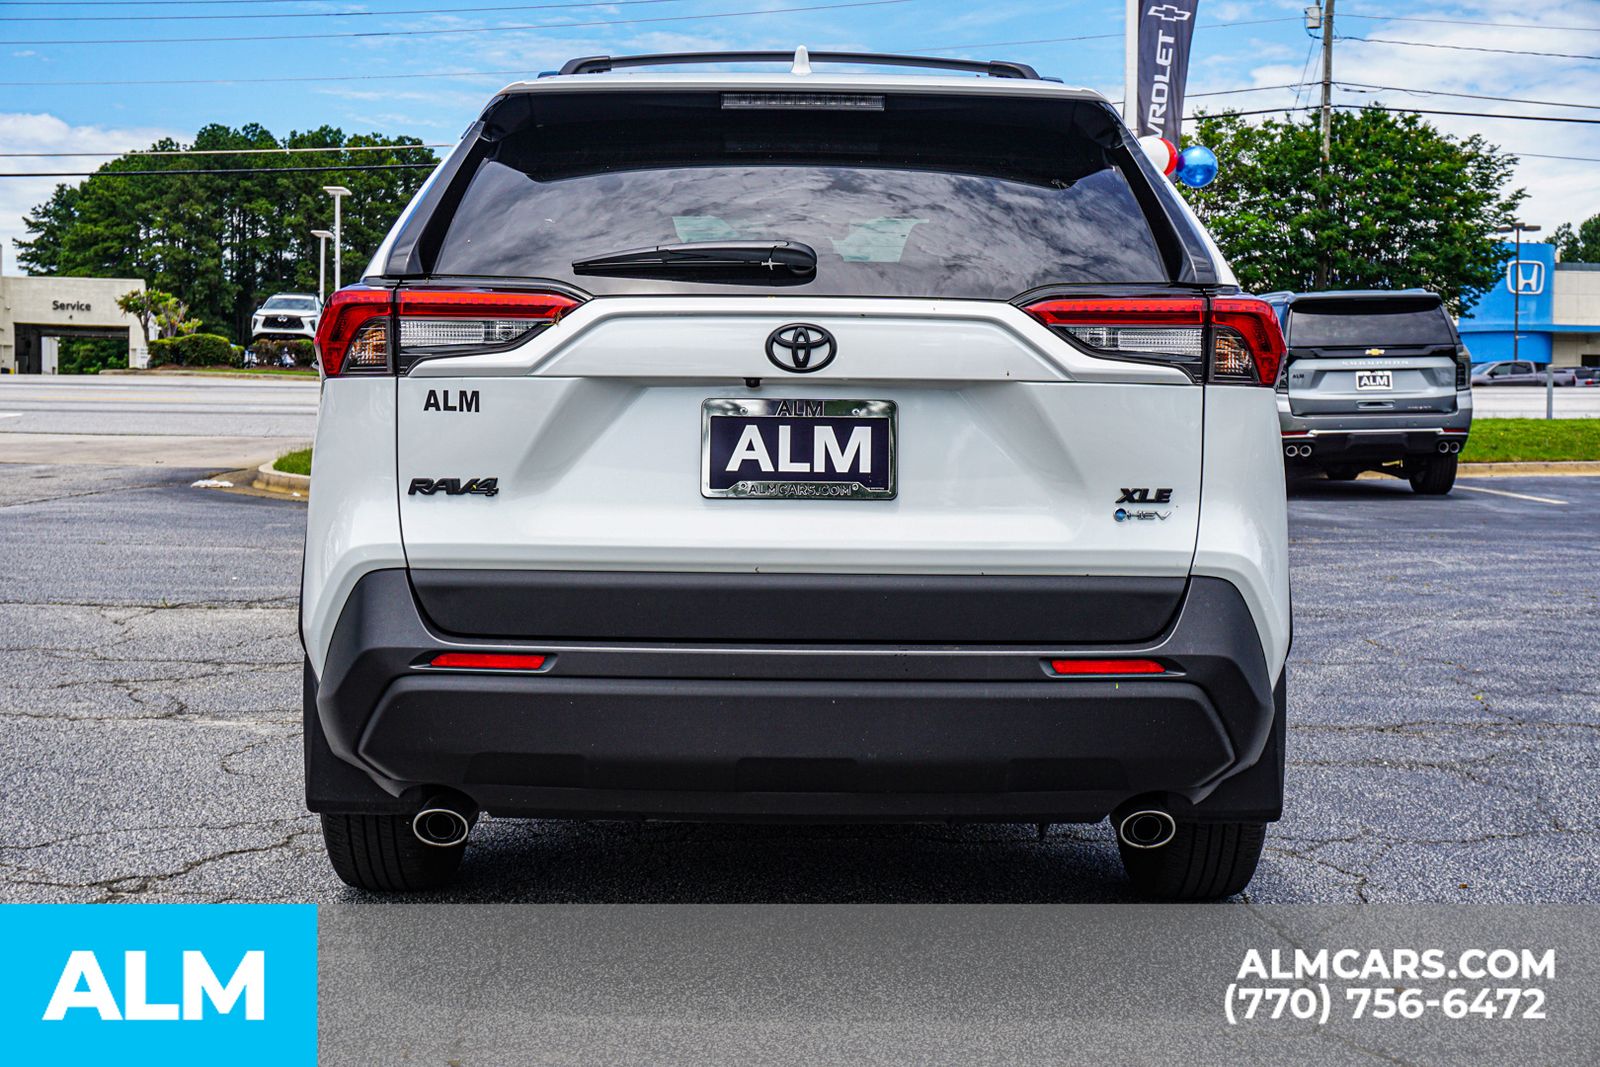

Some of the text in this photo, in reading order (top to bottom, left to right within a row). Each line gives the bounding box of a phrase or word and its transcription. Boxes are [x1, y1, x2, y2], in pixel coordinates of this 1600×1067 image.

[52, 300, 92, 312] Service
[1360, 376, 1388, 386] ALM
[423, 389, 480, 413] ALM
[776, 400, 825, 417] ALM
[725, 424, 872, 474] ALM
[407, 477, 500, 497] RAV4
[747, 483, 852, 496] ALMCARS.COM
[1115, 487, 1173, 504] XLE
